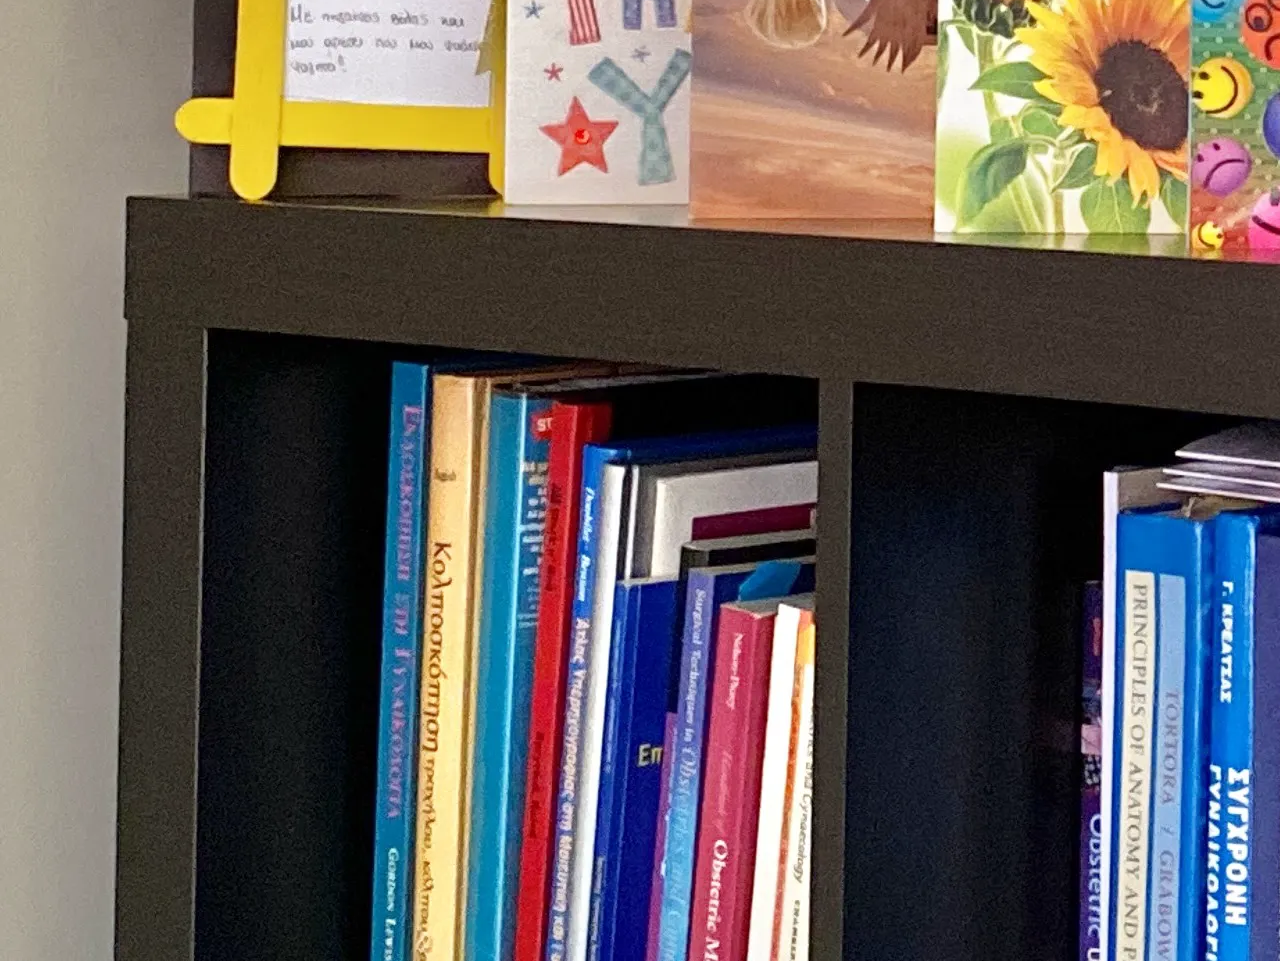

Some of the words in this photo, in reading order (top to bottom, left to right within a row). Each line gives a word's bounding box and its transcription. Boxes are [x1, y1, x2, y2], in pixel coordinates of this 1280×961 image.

[421, 542, 452, 753] Κολποσκόπηση
[691, 588, 708, 645] Surgical
[1128, 584, 1149, 716] PRINCIPLES
[1128, 724, 1145, 755] OF
[1161, 688, 1180, 805] TORTORA
[1125, 762, 1144, 879] ANATOMY
[1225, 767, 1250, 925] ΣΥΓΧΡΟΝΗ
[706, 840, 730, 930] Obstetric
[1123, 886, 1142, 938] AND
